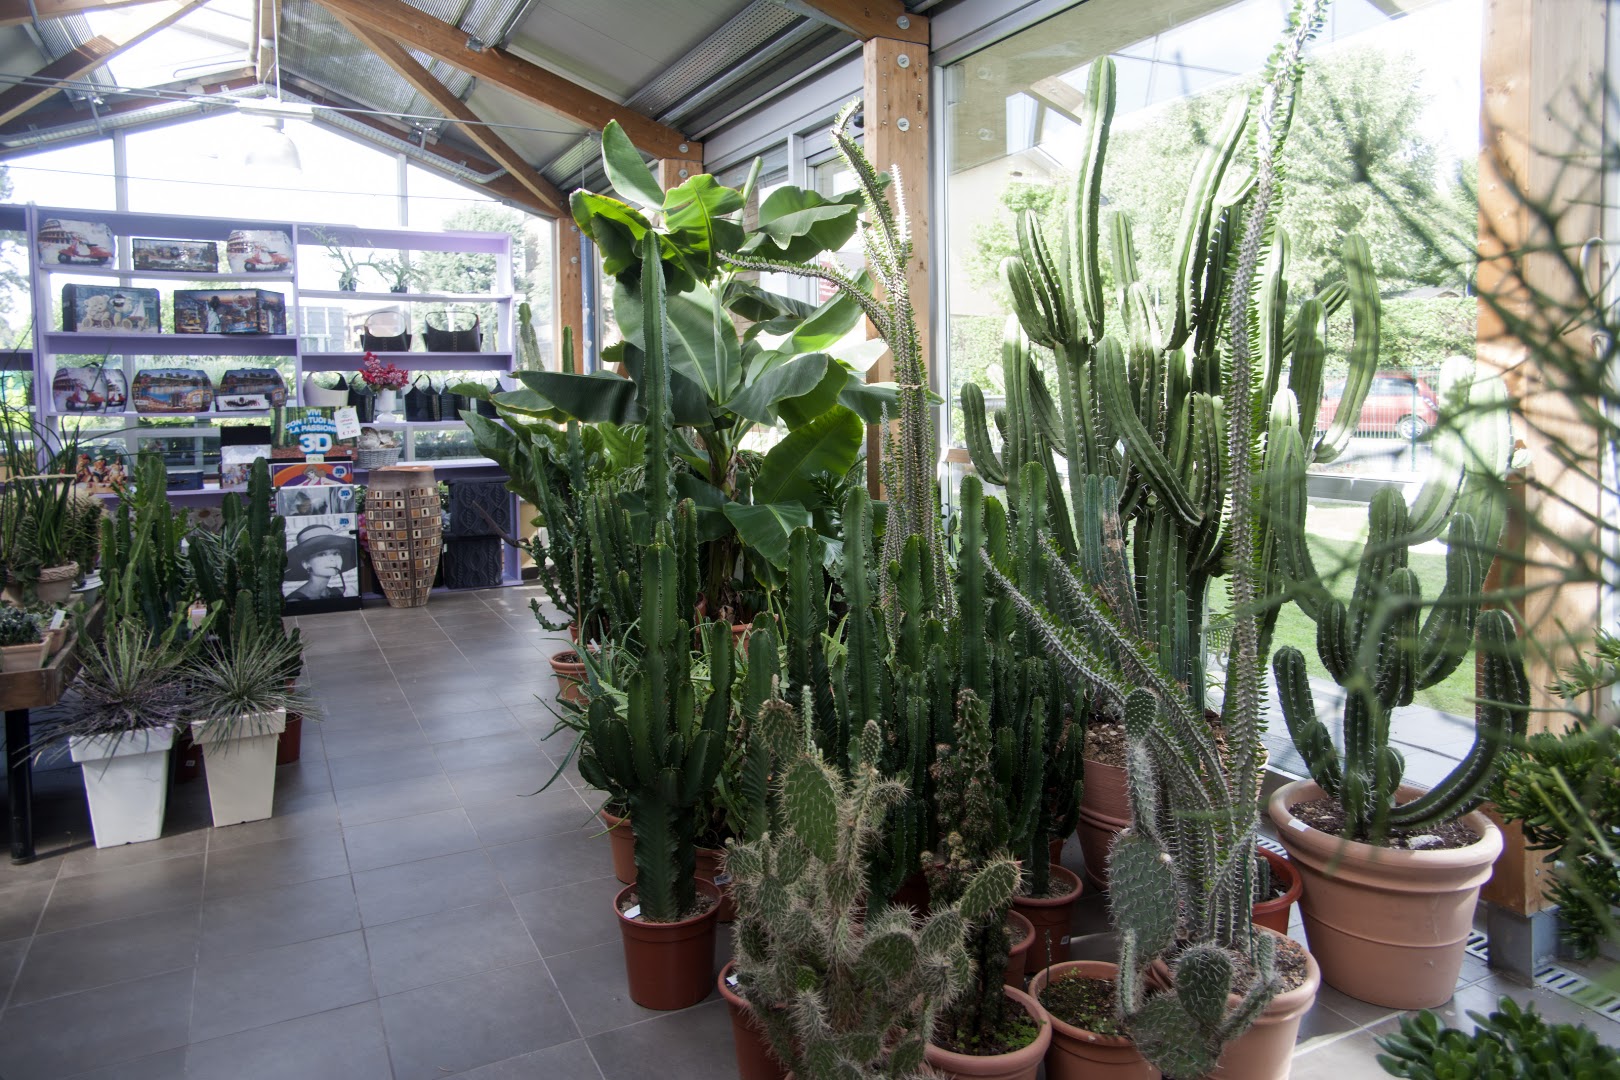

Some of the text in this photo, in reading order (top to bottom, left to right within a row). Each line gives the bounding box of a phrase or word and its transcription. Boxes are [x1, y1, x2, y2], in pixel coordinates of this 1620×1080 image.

[286, 418, 302, 430] CON
[308, 416, 326, 424] TUOI
[300, 433, 332, 453] 3D
